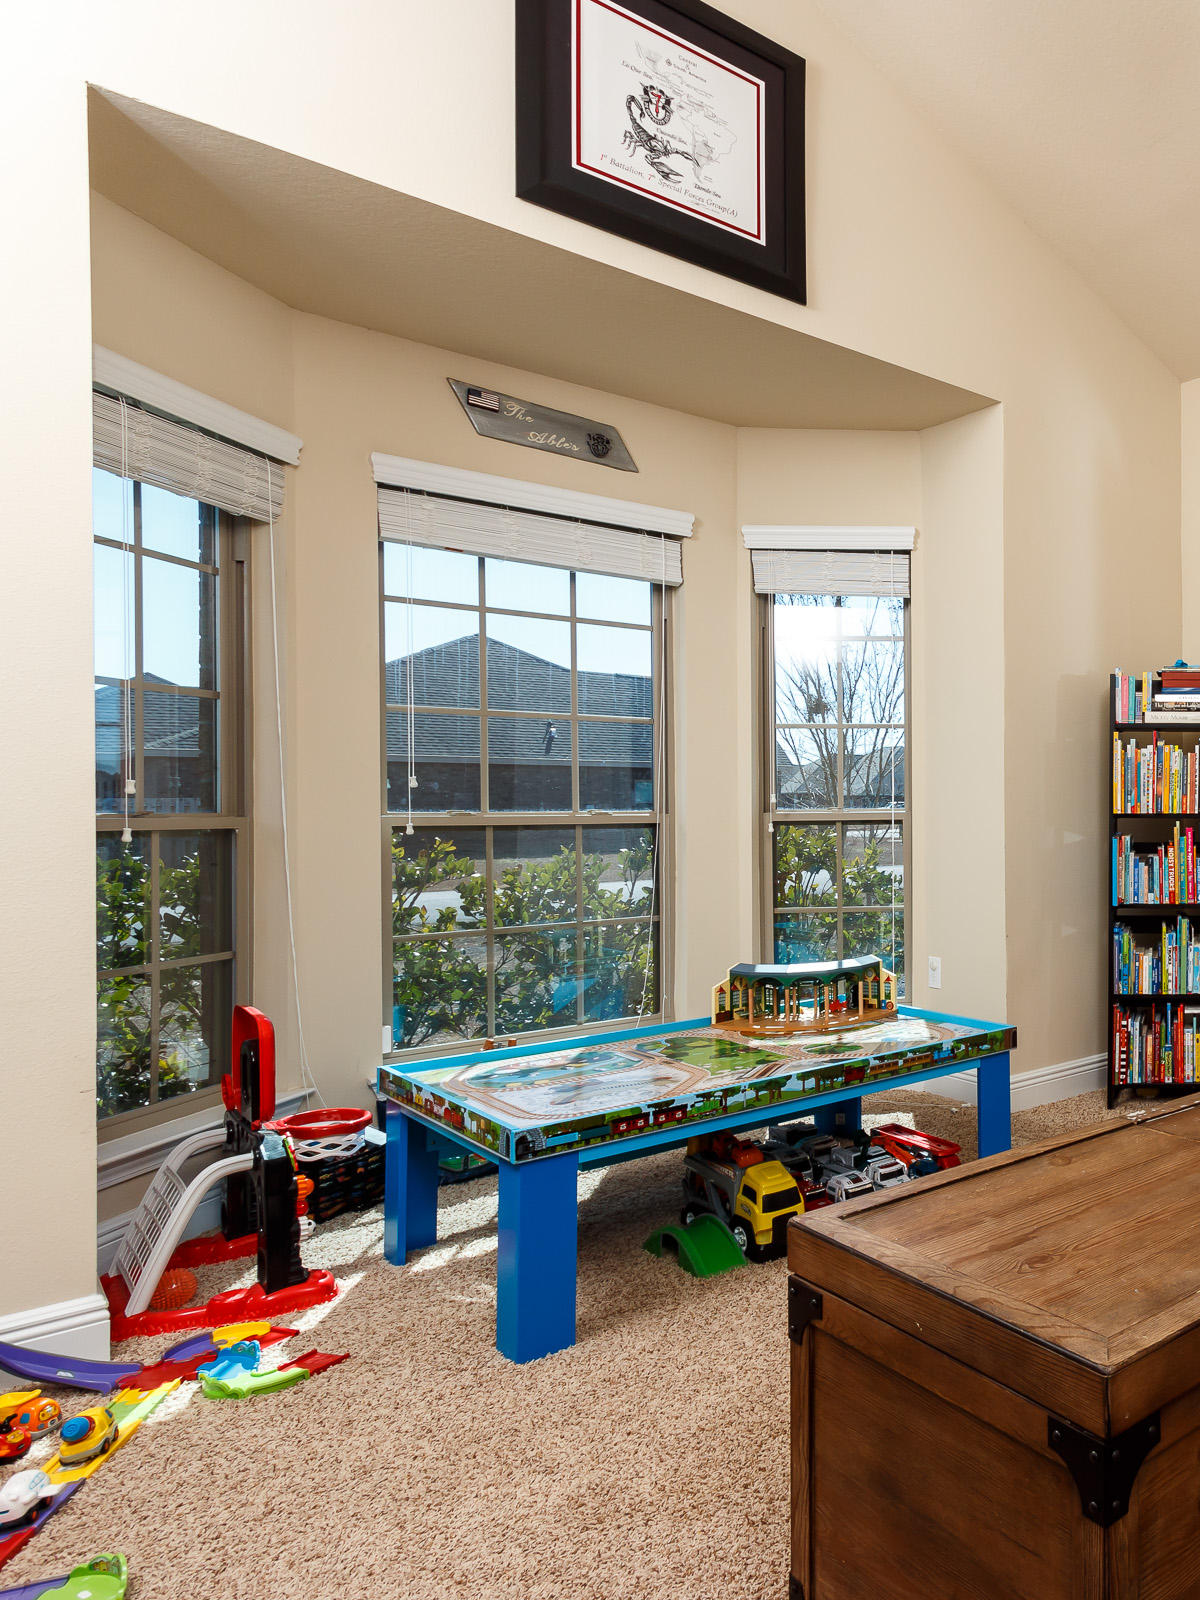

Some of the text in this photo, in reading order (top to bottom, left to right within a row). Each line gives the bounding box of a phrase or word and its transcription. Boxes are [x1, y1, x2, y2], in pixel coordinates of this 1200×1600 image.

[657, 178, 683, 194] Special
[683, 189, 705, 203] Forces
[503, 401, 535, 423] The
